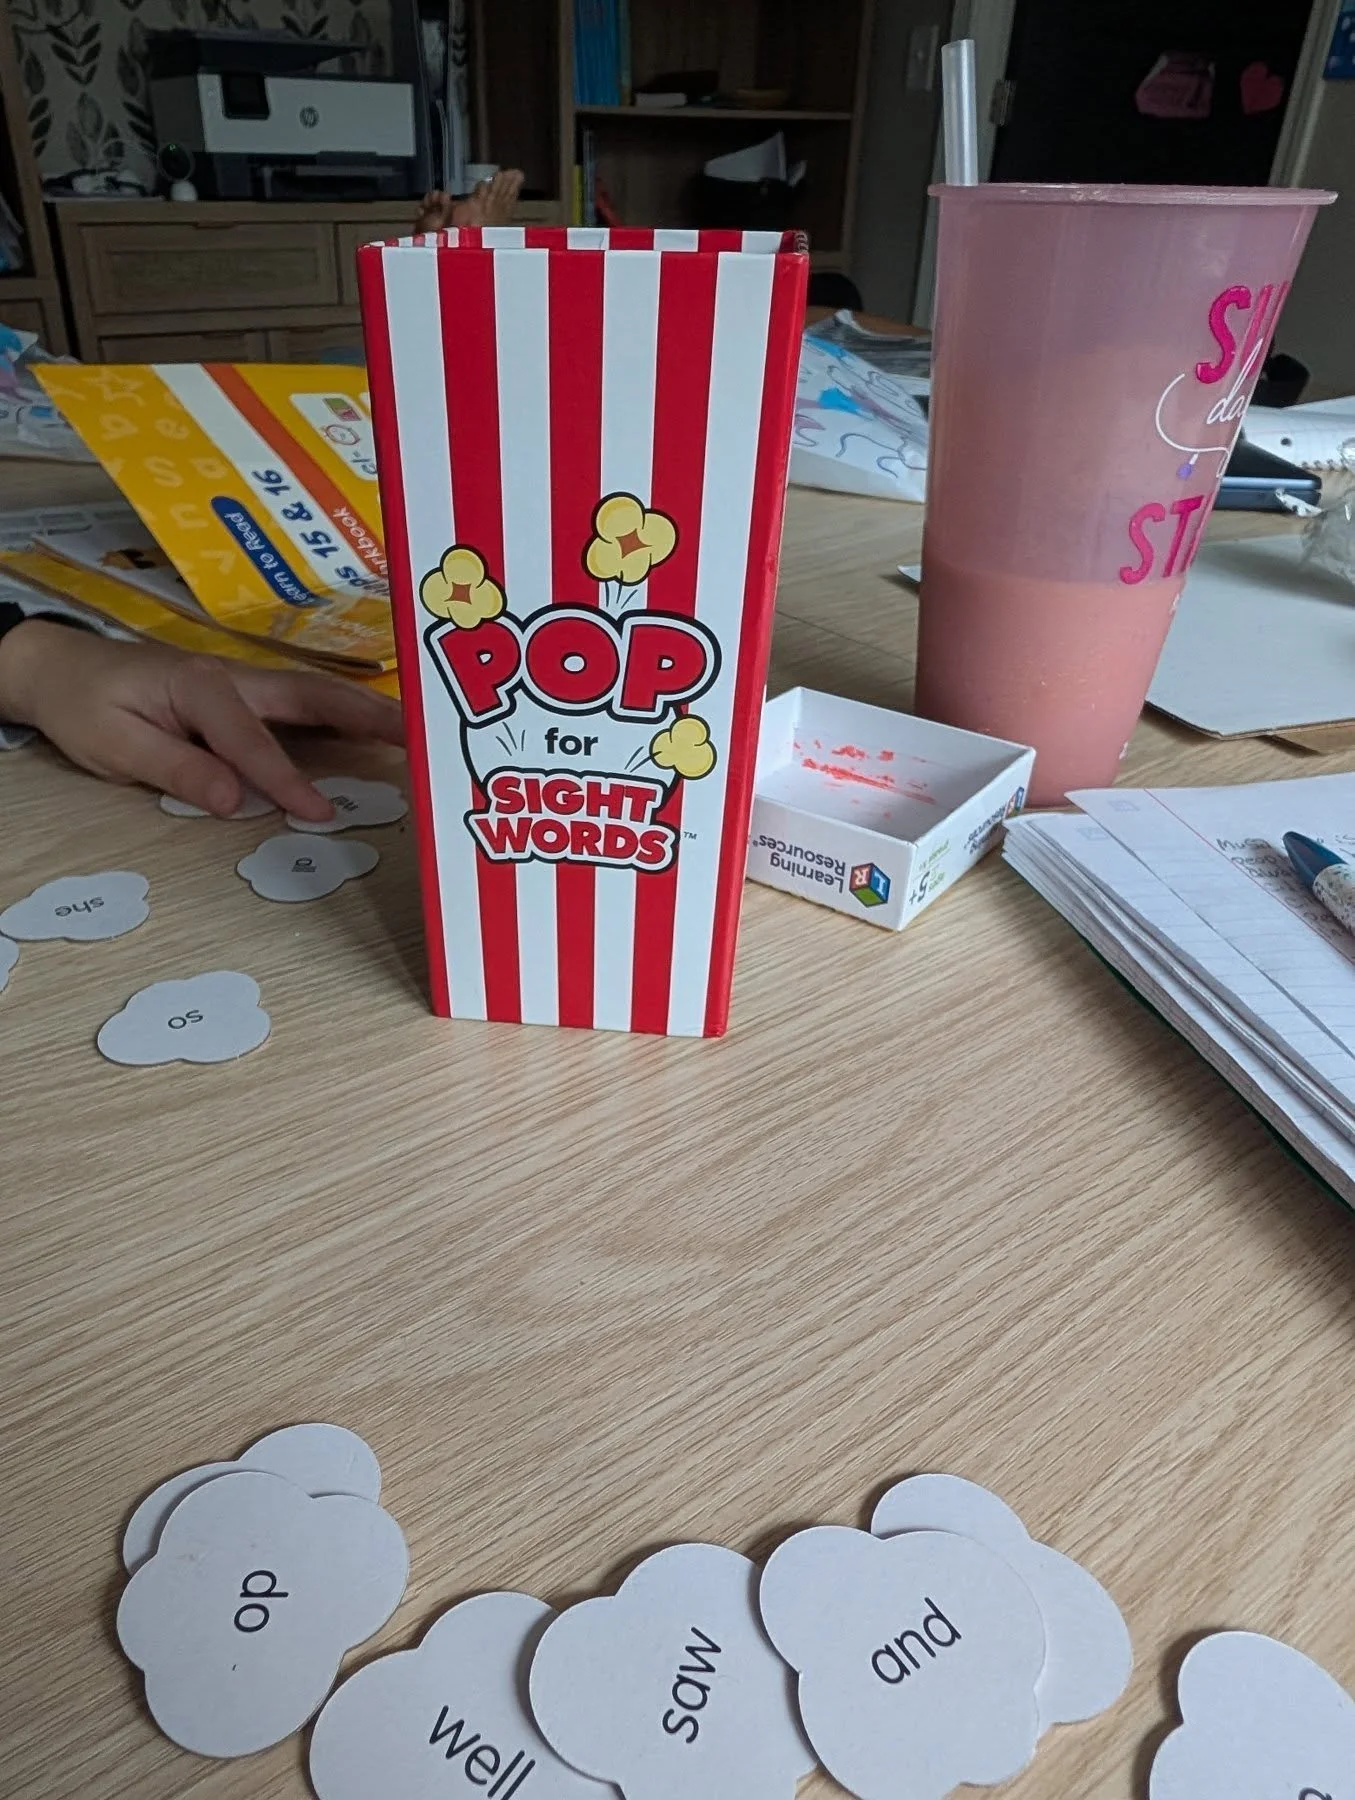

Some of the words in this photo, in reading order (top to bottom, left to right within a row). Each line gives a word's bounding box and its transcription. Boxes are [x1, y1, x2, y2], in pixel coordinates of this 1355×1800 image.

[251, 469, 291, 496] 16
[281, 501, 313, 522] &
[224, 511, 266, 551] Read
[300, 530, 340, 559] 15
[259, 552, 279, 570] to
[436, 616, 708, 717] POP
[544, 727, 598, 757] for
[490, 775, 657, 823] SIGHT
[474, 817, 668, 865] WORDS
[768, 852, 844, 893] Learning
[908, 871, 930, 905] 5+
[55, 896, 105, 918] she
[167, 1009, 204, 1030] so
[871, 1597, 963, 1685] and
[662, 1626, 722, 1744] saw
[429, 1704, 536, 1800] well
